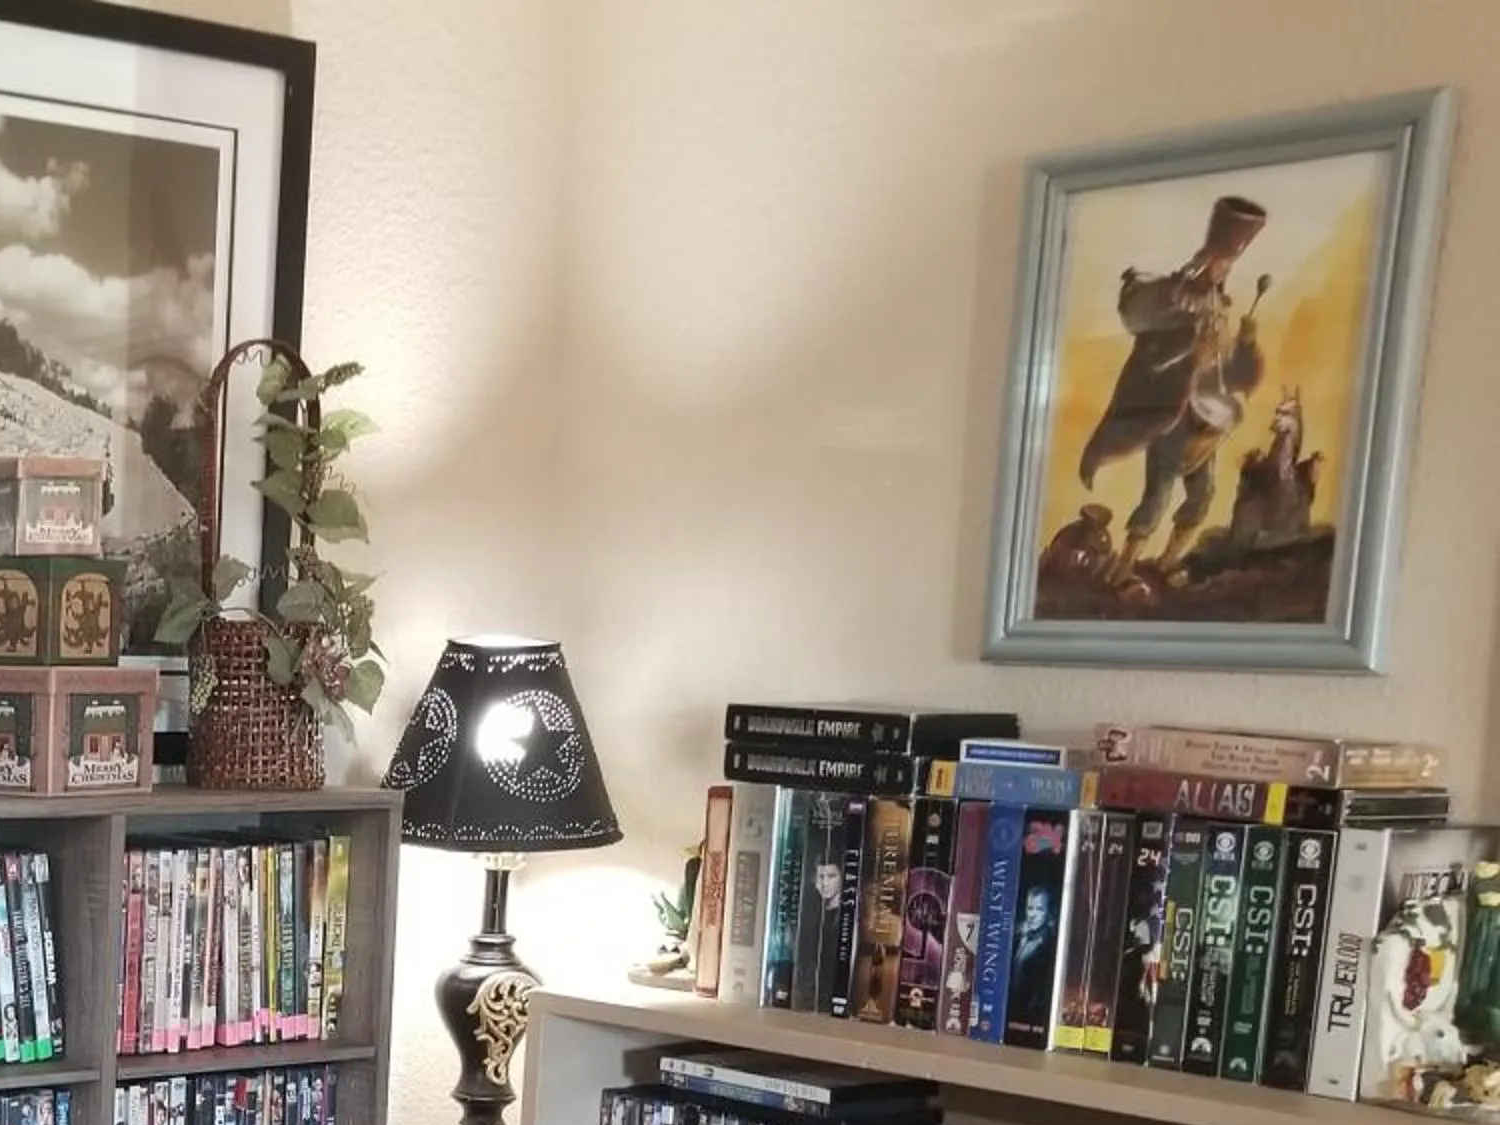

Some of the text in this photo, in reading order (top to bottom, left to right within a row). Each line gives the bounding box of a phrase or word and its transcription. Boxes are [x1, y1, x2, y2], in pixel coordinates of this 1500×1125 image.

[817, 721, 861, 738] EMPIRE
[818, 761, 864, 779] EMPIRE
[1175, 779, 1256, 817] ALIAS
[1137, 848, 1162, 867] 24
[983, 861, 1009, 982] WEST WING
[1204, 874, 1237, 946] CSI:
[1245, 885, 1275, 954] CSI:
[1292, 883, 1318, 957] CSI:
[43, 930, 57, 985] SCREAM
[1171, 906, 1193, 982] CSI:
